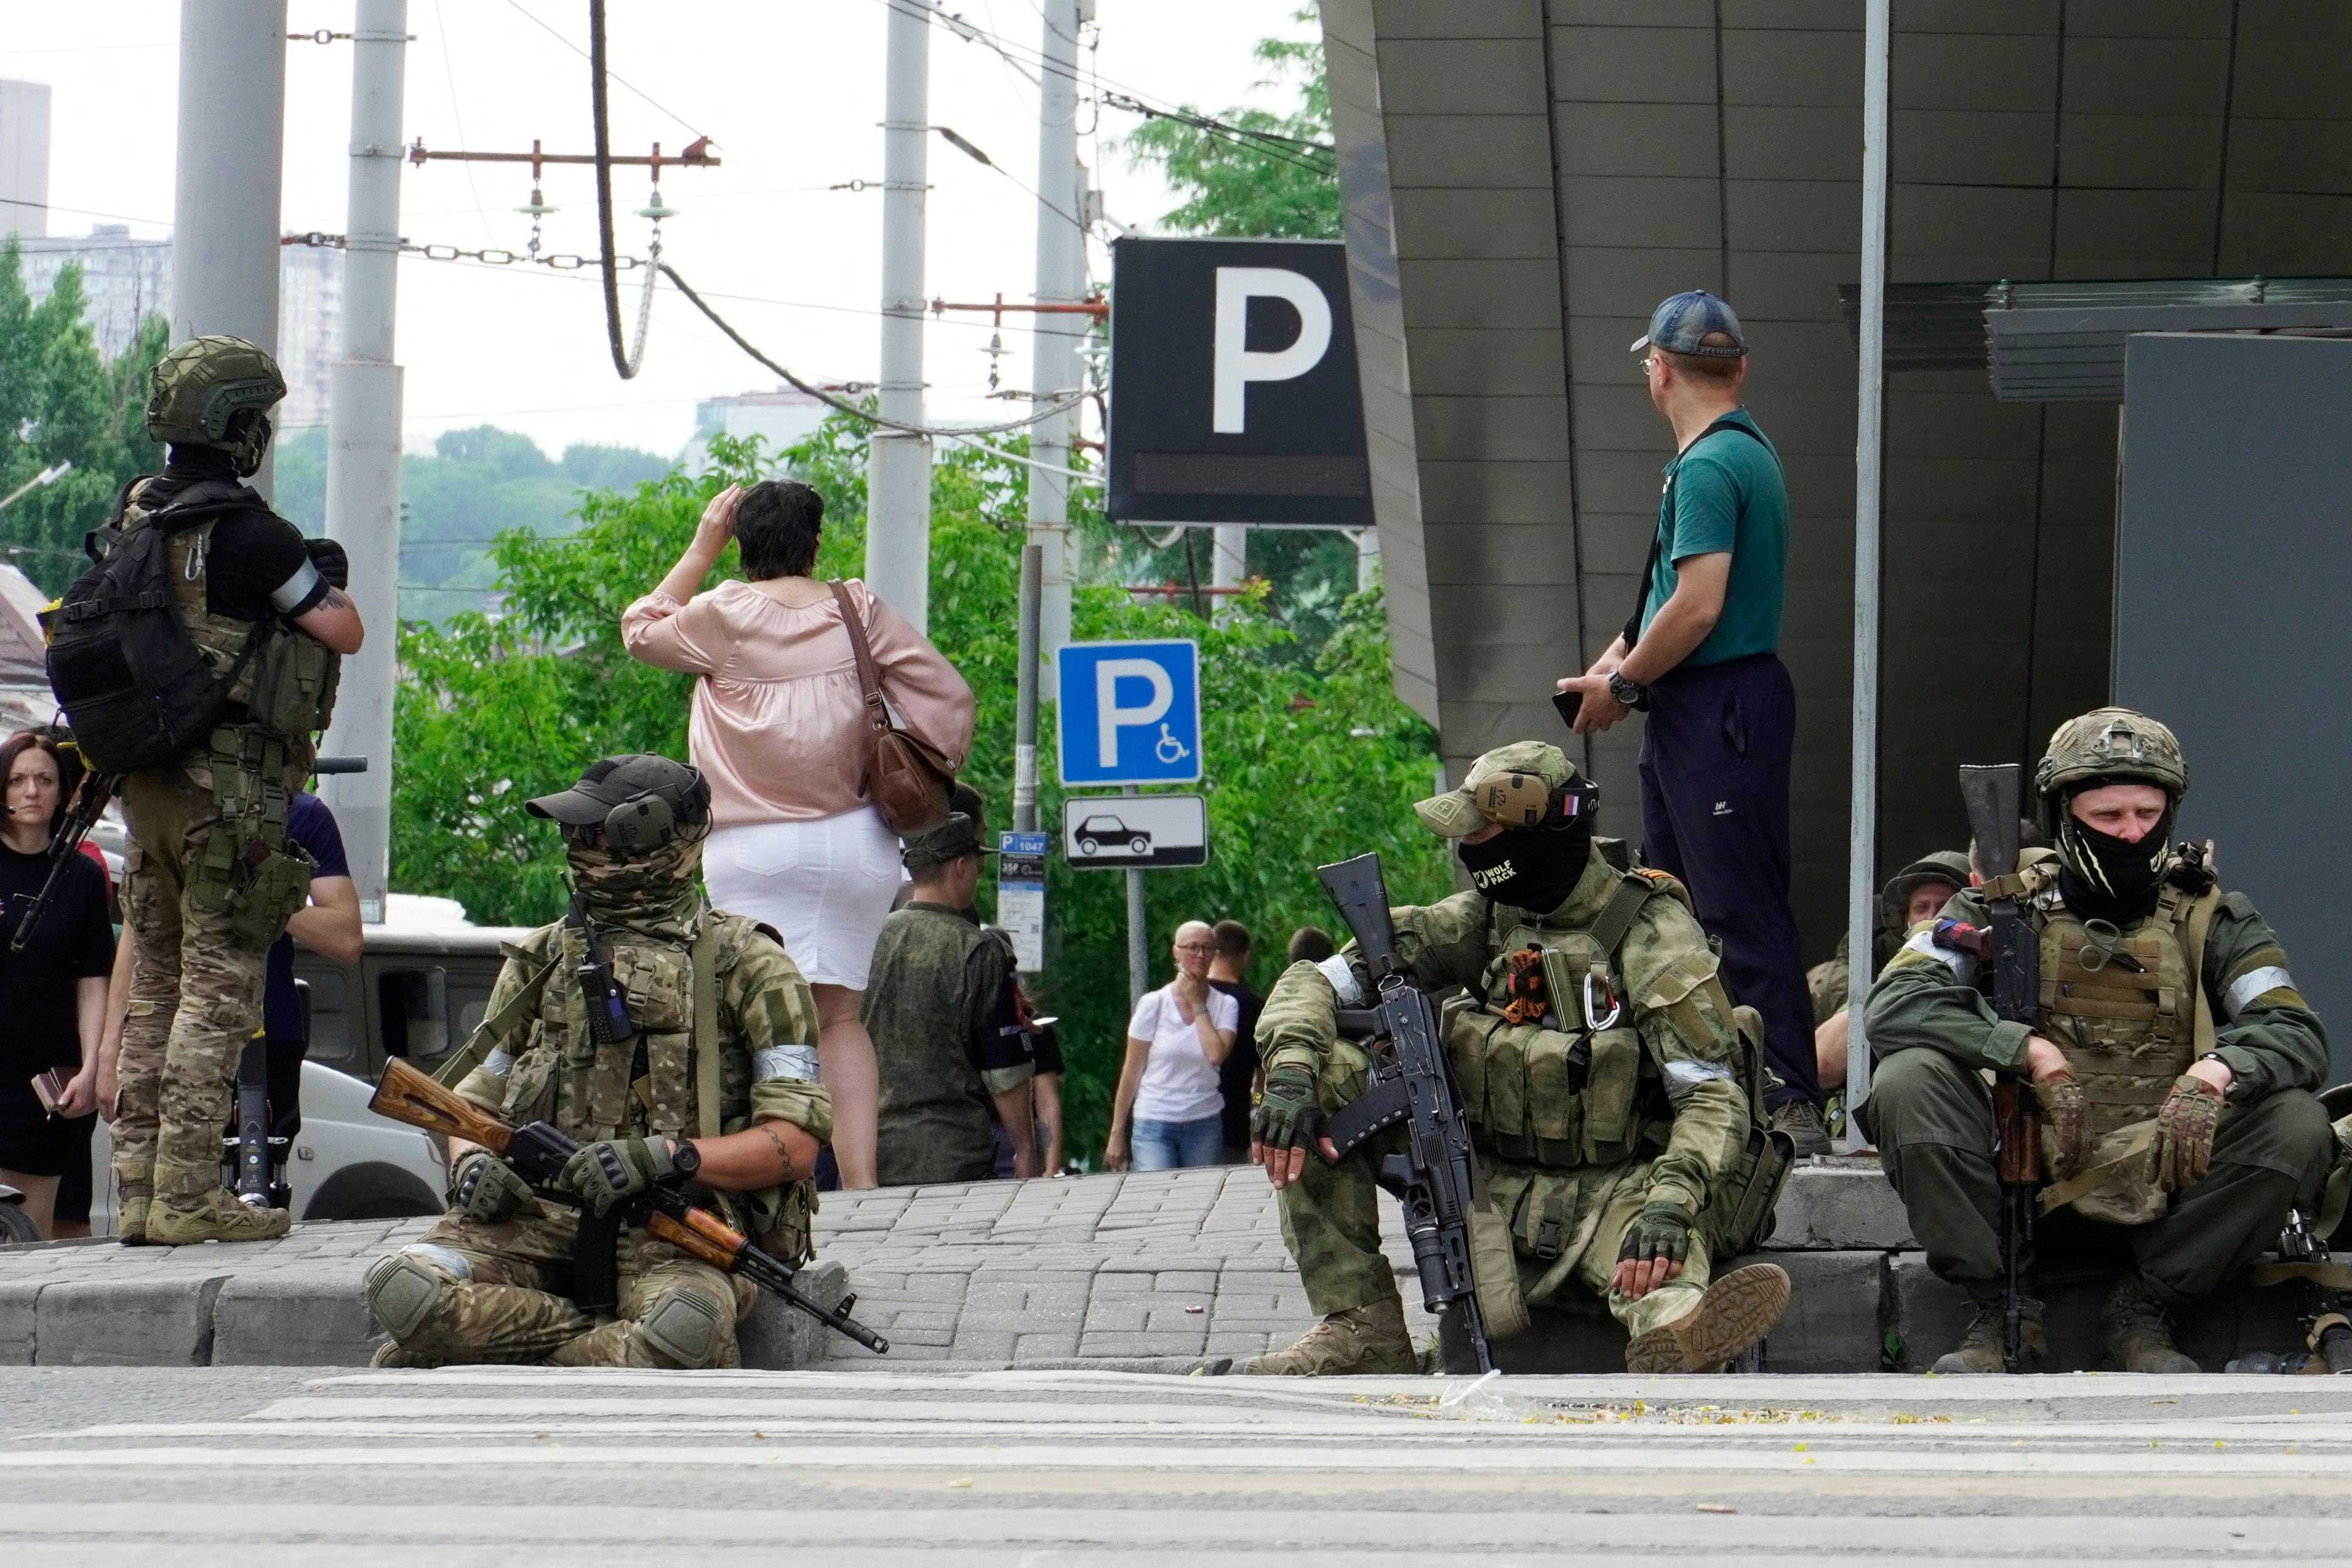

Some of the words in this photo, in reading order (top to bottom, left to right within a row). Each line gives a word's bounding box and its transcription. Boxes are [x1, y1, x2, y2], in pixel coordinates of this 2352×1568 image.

[1213, 267, 1332, 434] P
[1096, 659, 1173, 767] P
[1002, 835, 1013, 849] P
[1019, 841, 1044, 851] 1047
[1485, 859, 1511, 878] WOLF
[1490, 867, 1517, 885] PACK
